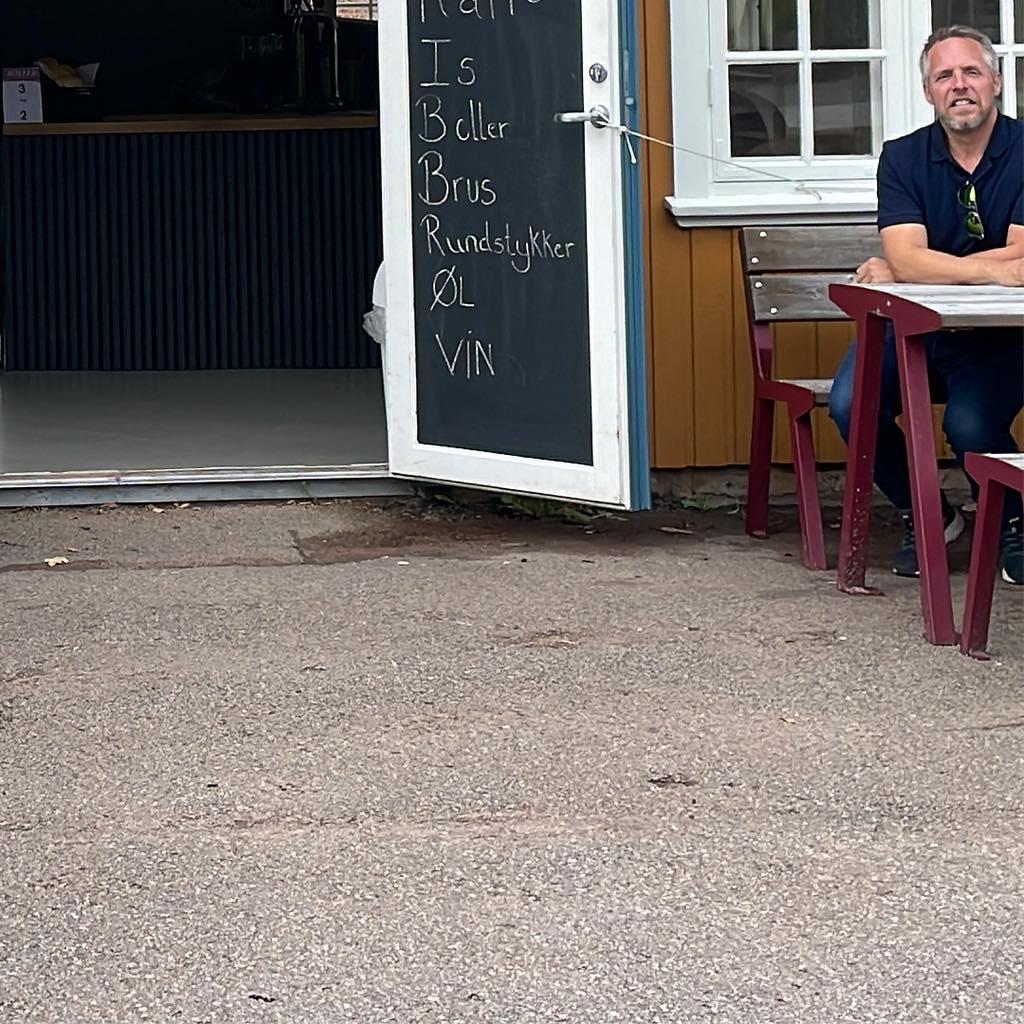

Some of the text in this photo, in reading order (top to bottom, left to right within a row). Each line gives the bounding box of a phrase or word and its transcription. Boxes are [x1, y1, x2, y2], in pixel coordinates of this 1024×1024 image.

[420, 39, 477, 87] Is
[18, 83, 26, 94] 3
[19, 110, 28, 121] 2
[418, 150, 497, 206] Brus
[420, 213, 576, 273] Rundstykker
[430, 264, 475, 312] ØL
